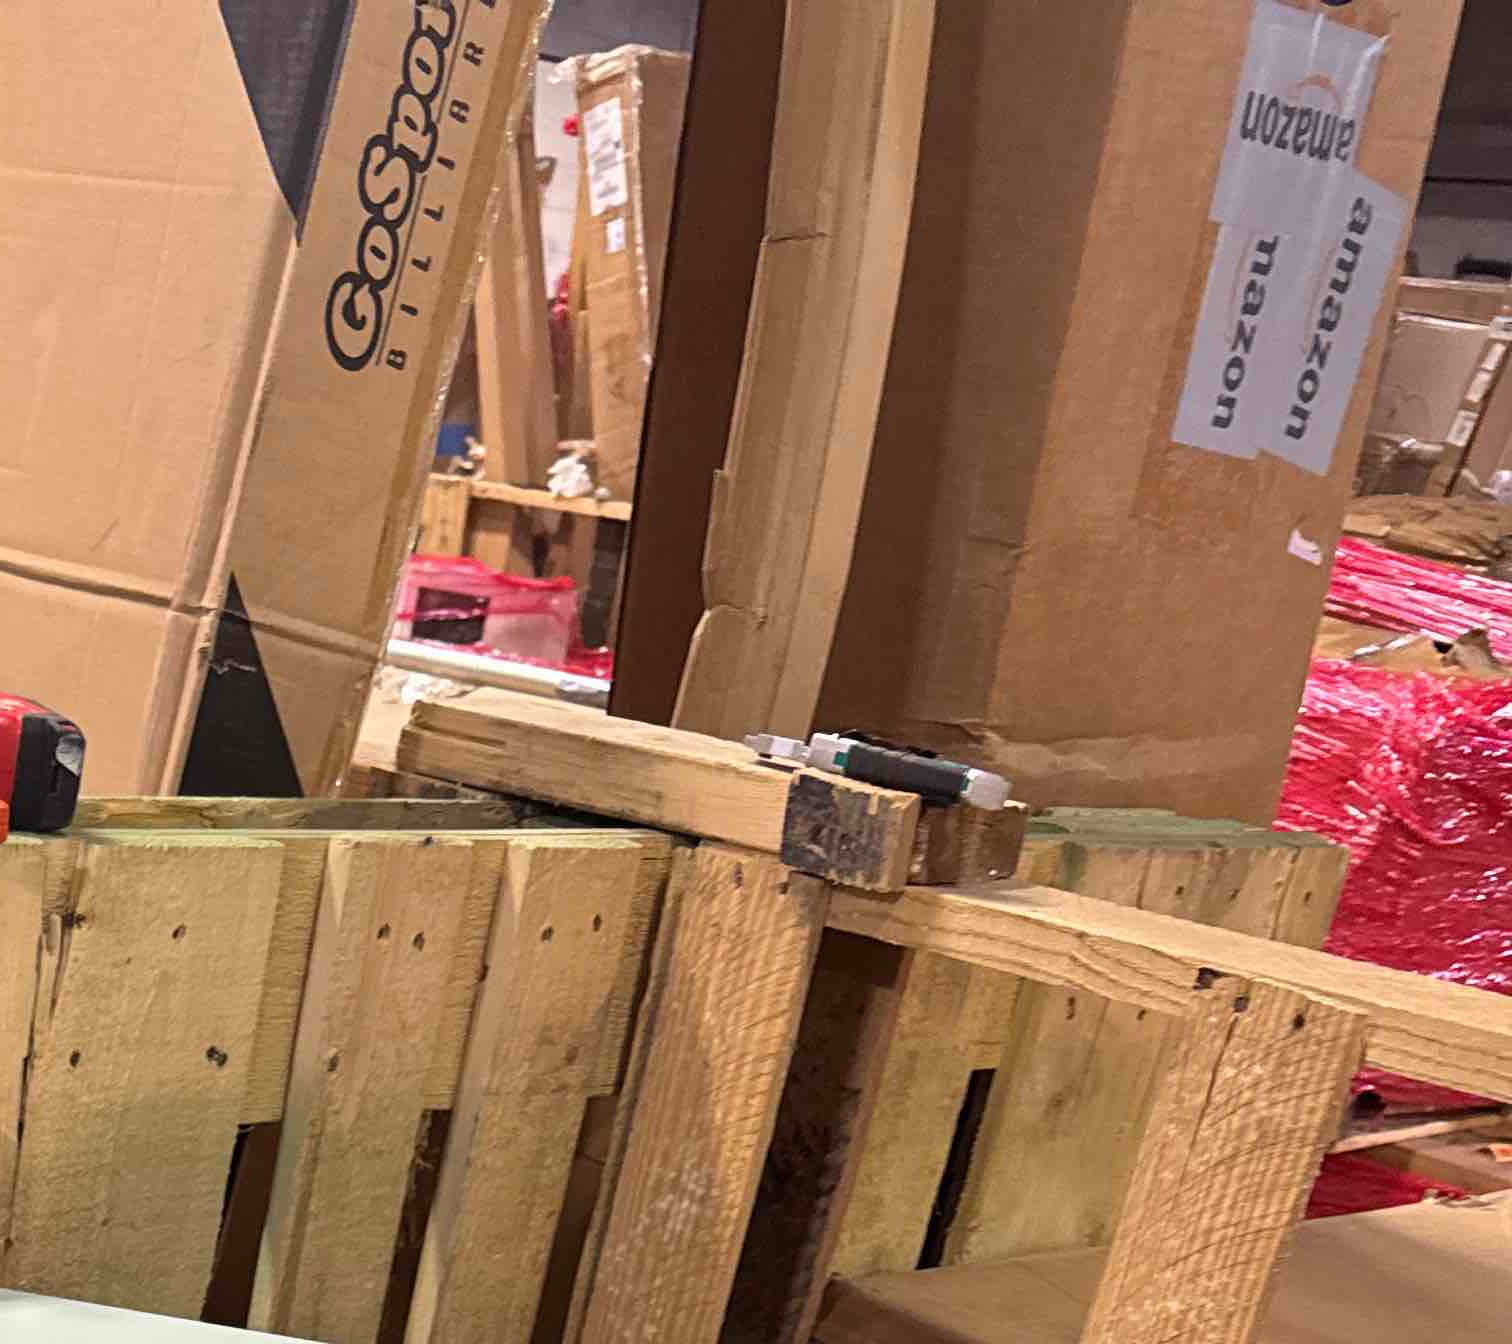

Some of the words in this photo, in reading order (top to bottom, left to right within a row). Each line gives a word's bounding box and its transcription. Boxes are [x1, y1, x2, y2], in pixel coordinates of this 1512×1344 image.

[325, 0, 457, 372] GoSpor
[386, 0, 497, 371] BILLIAR
[1239, 91, 1356, 162] amazon
[1211, 235, 1280, 430] mazon
[1284, 197, 1375, 440] amazon
